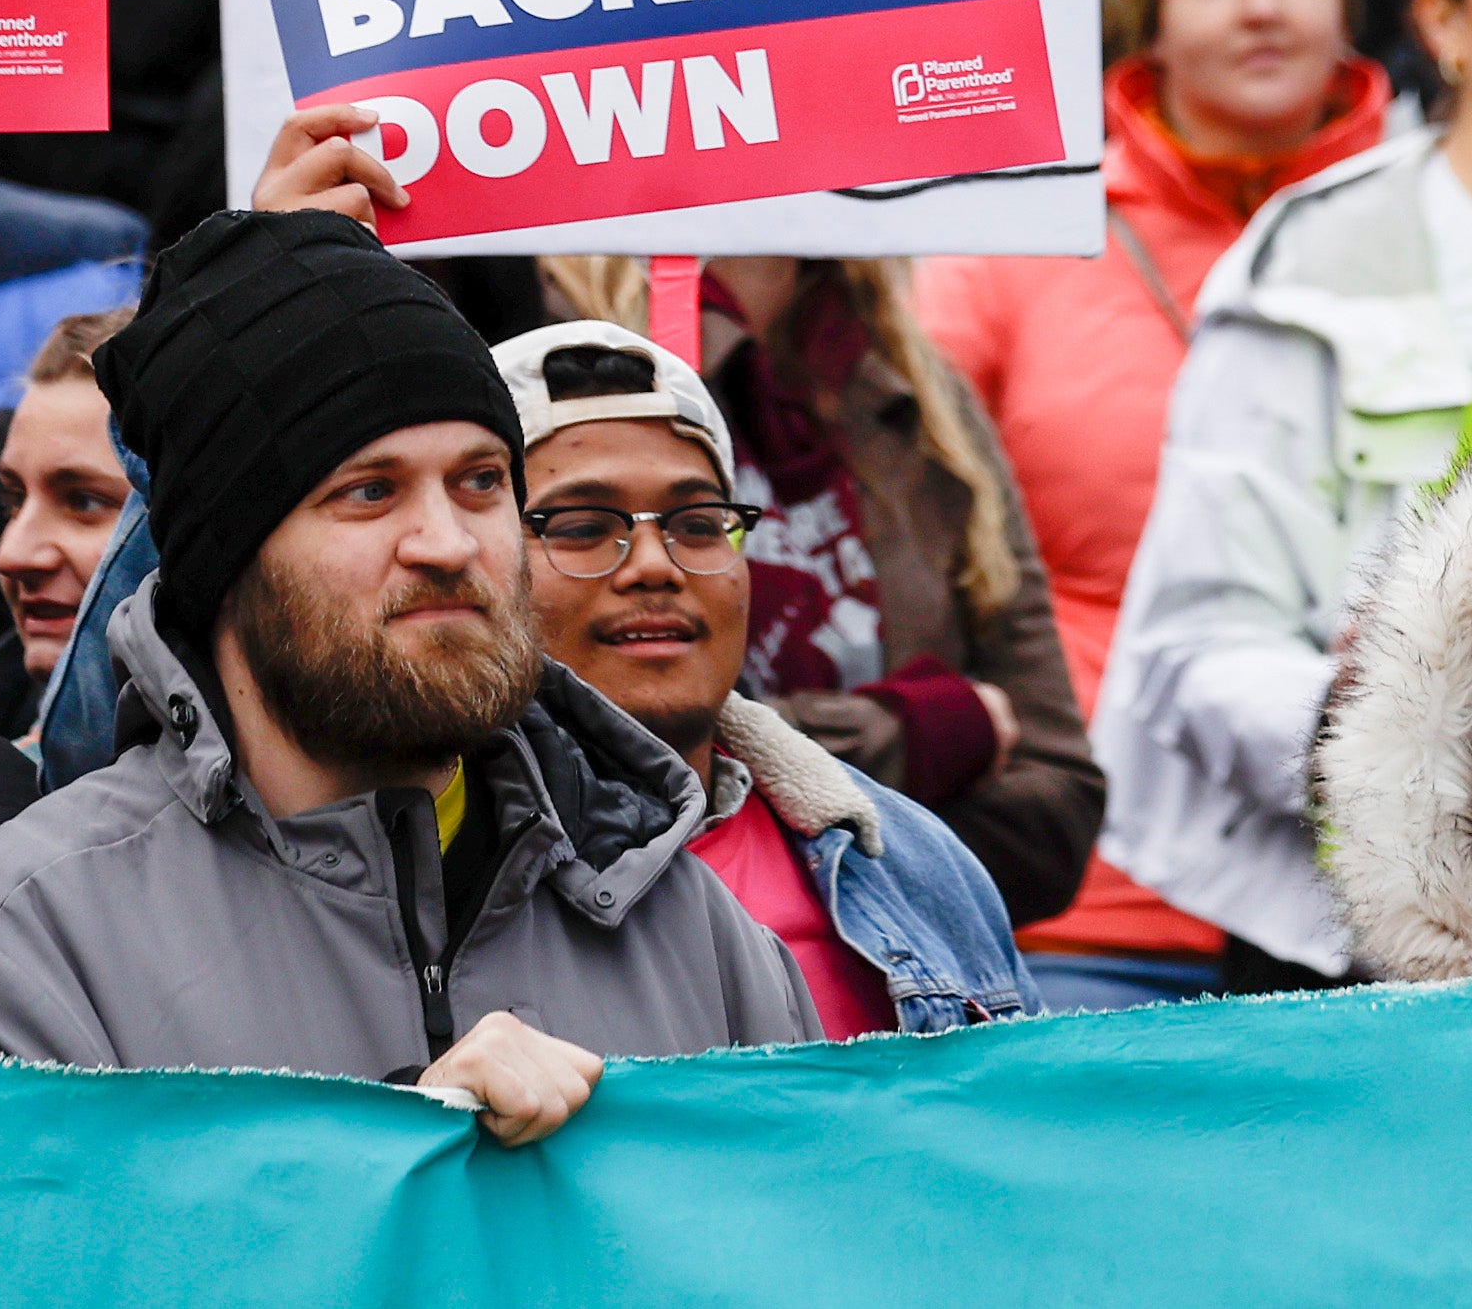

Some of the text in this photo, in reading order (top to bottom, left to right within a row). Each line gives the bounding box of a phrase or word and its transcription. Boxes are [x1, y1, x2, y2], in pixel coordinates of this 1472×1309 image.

[922, 54, 983, 77] Planned
[925, 69, 1014, 92] Parenthood
[349, 49, 779, 188] DOWN
